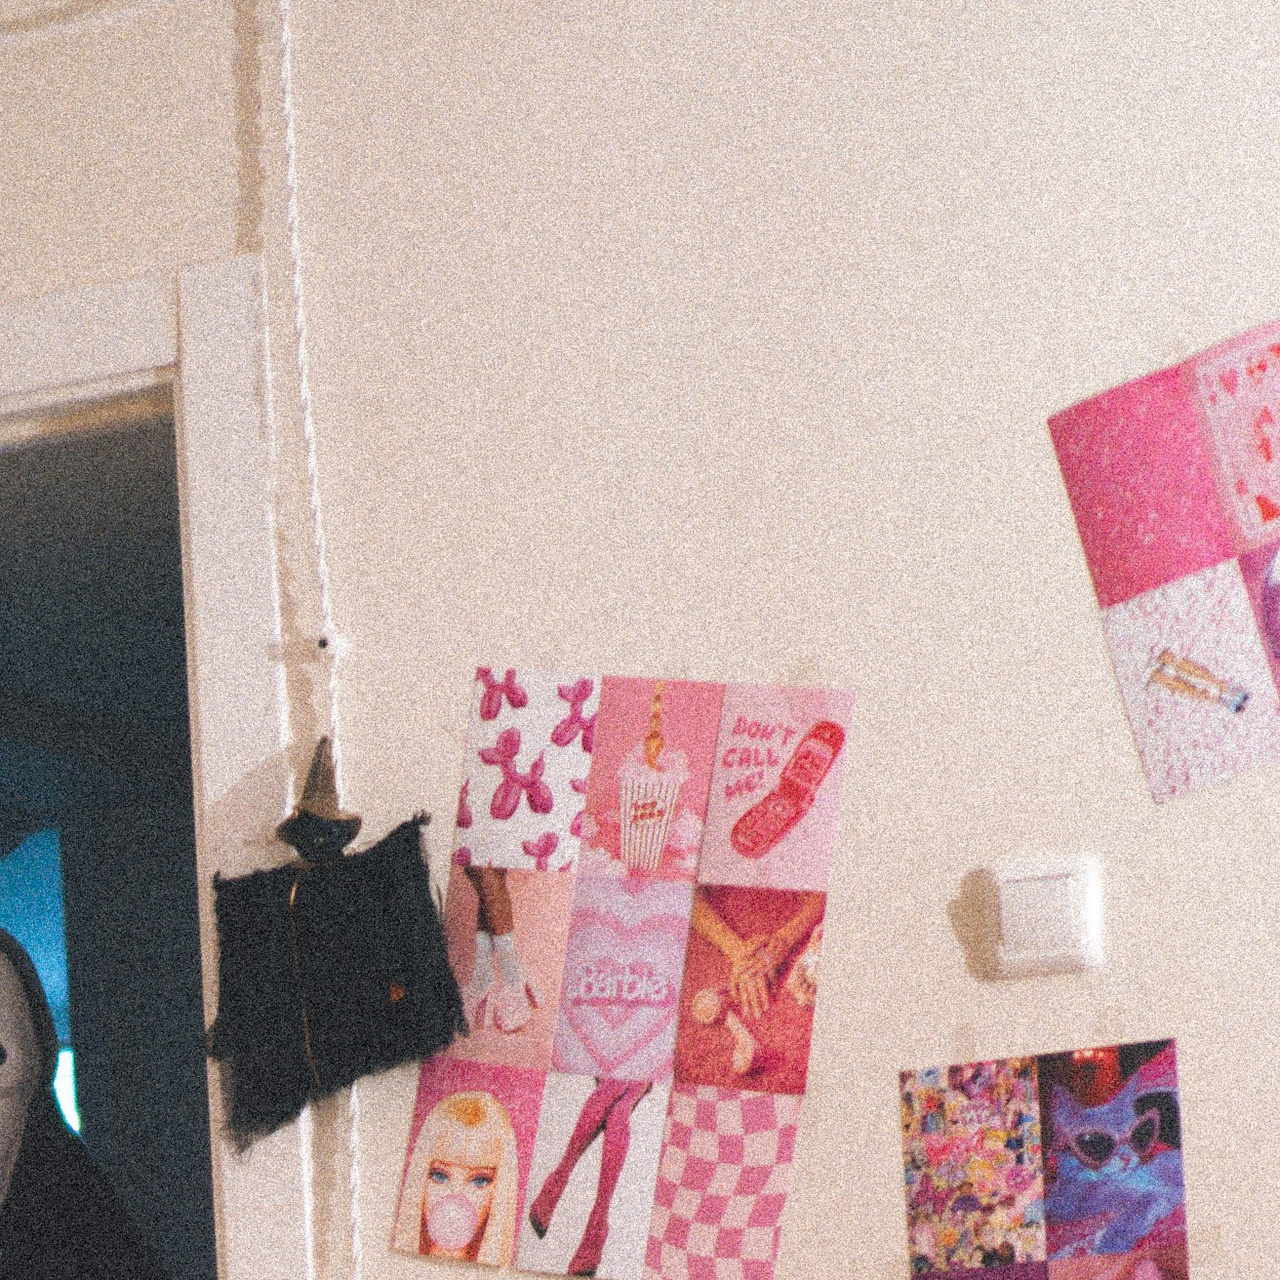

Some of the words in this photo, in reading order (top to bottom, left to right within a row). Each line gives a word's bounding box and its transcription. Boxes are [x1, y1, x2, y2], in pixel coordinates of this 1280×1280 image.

[731, 716, 796, 746] DON'T
[722, 747, 780, 769] CALL
[566, 963, 669, 1000] Barbie
